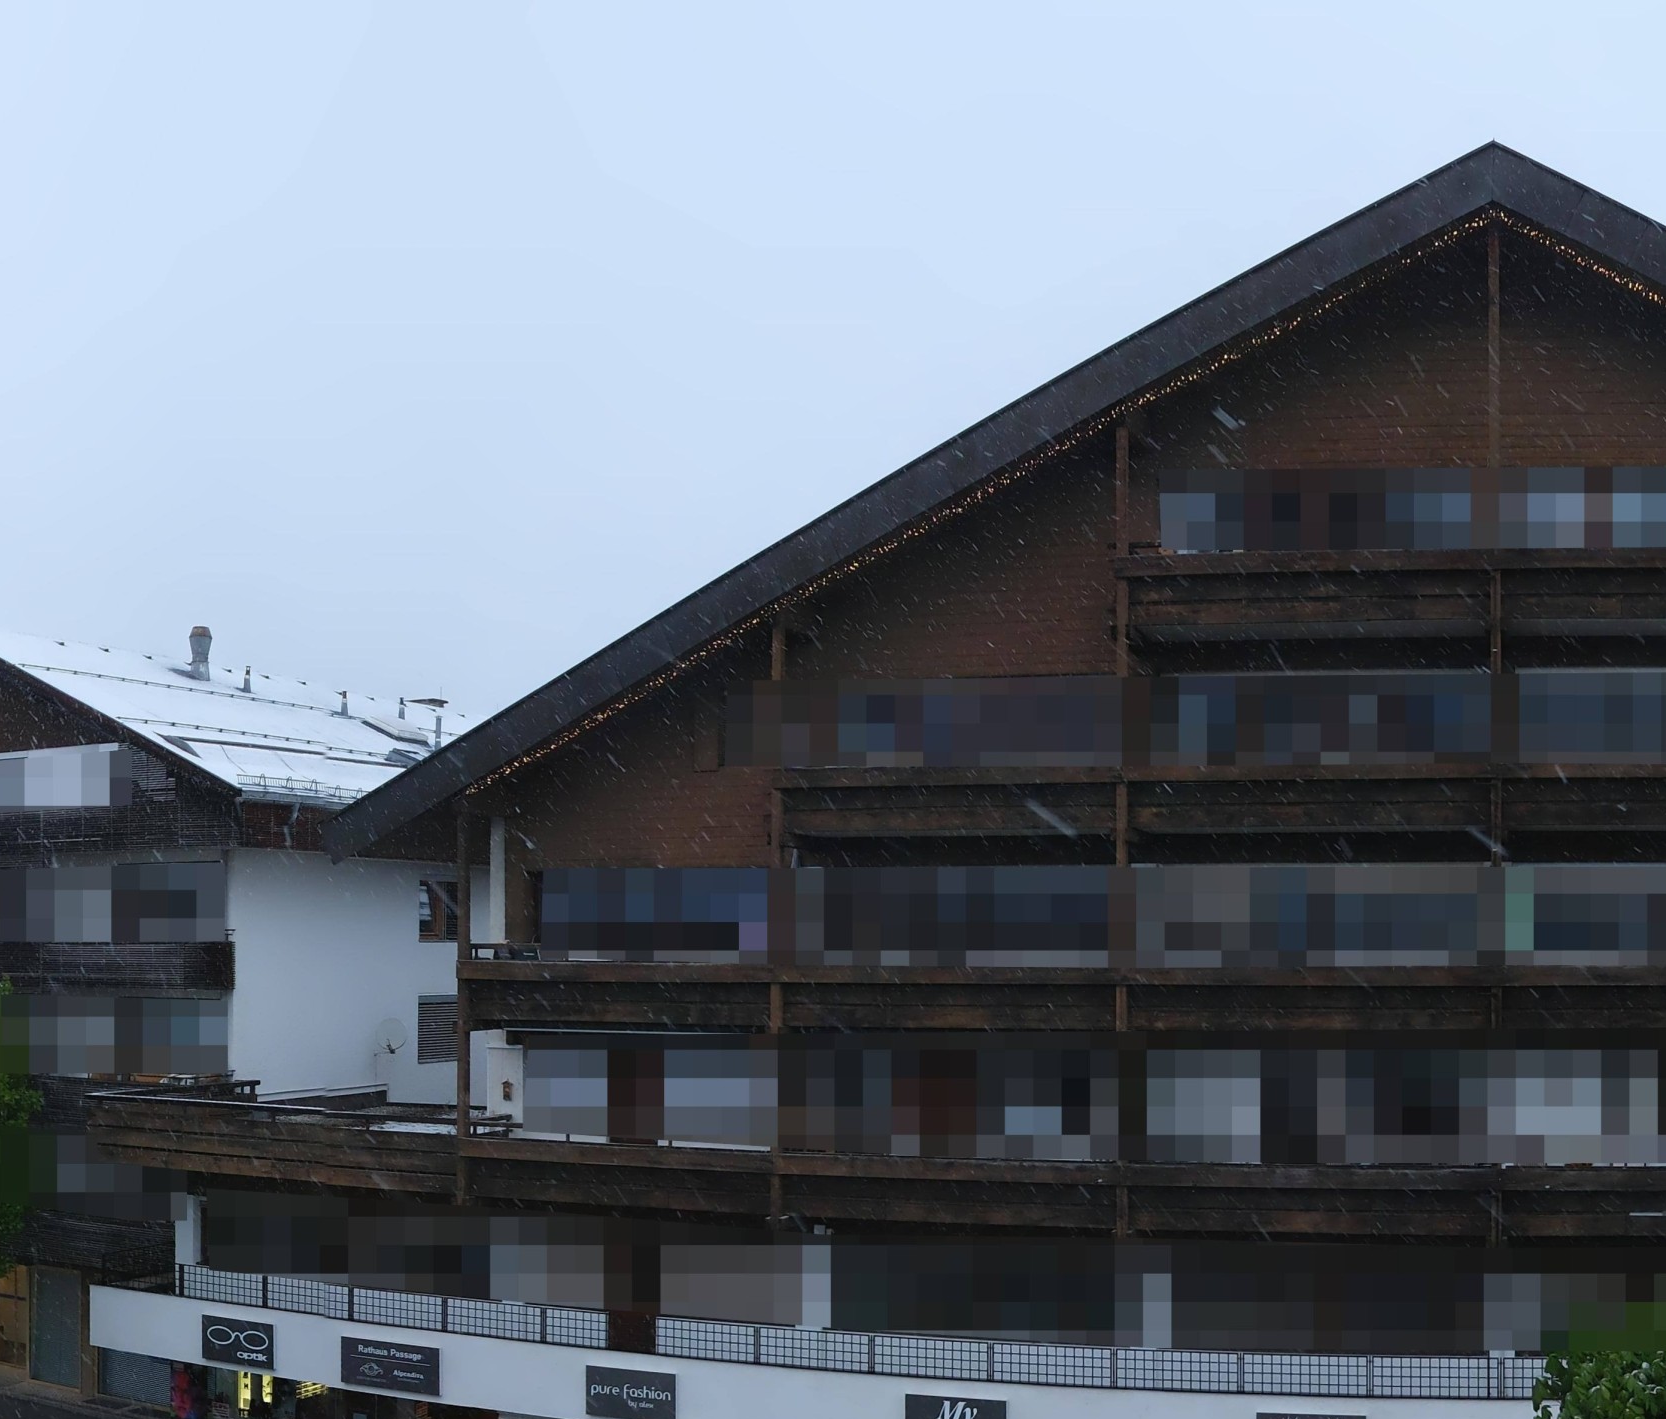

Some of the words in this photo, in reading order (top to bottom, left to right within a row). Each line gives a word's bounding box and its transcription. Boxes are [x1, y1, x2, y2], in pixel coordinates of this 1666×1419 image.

[237, 1351, 269, 1362] optik
[358, 1344, 388, 1356] Rathaus
[390, 1348, 422, 1362] Passage
[590, 1383, 620, 1396] pure
[623, 1383, 671, 1401] fashion
[627, 1400, 637, 1409] by
